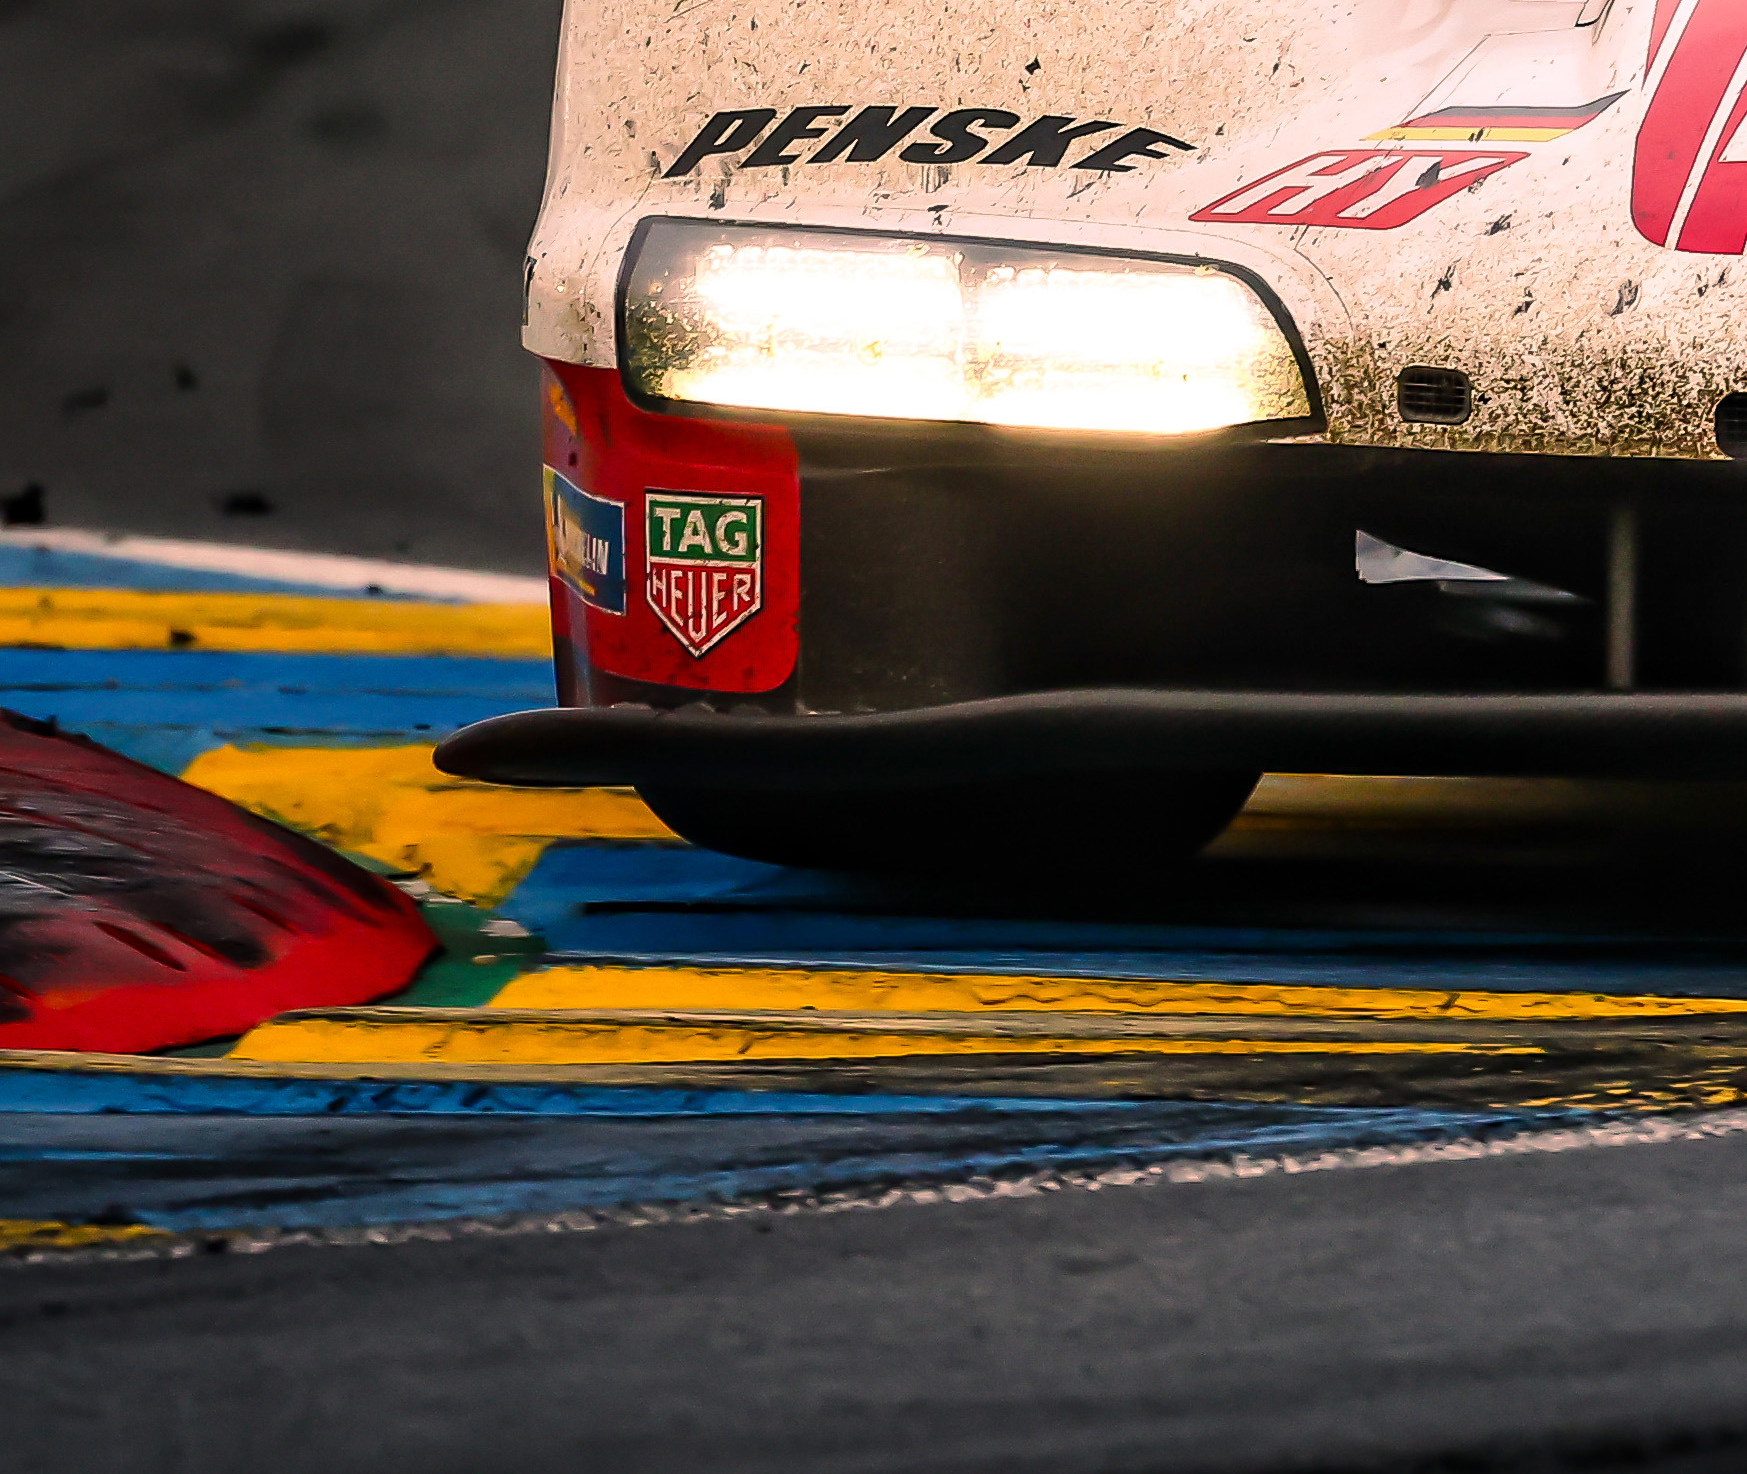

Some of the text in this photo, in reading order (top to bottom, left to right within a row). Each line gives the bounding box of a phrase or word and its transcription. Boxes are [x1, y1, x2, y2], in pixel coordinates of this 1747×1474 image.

[662, 104, 1199, 180] PENSKE
[1210, 154, 1507, 220] HY
[654, 507, 749, 556] TAG
[651, 566, 752, 643] HEUER
